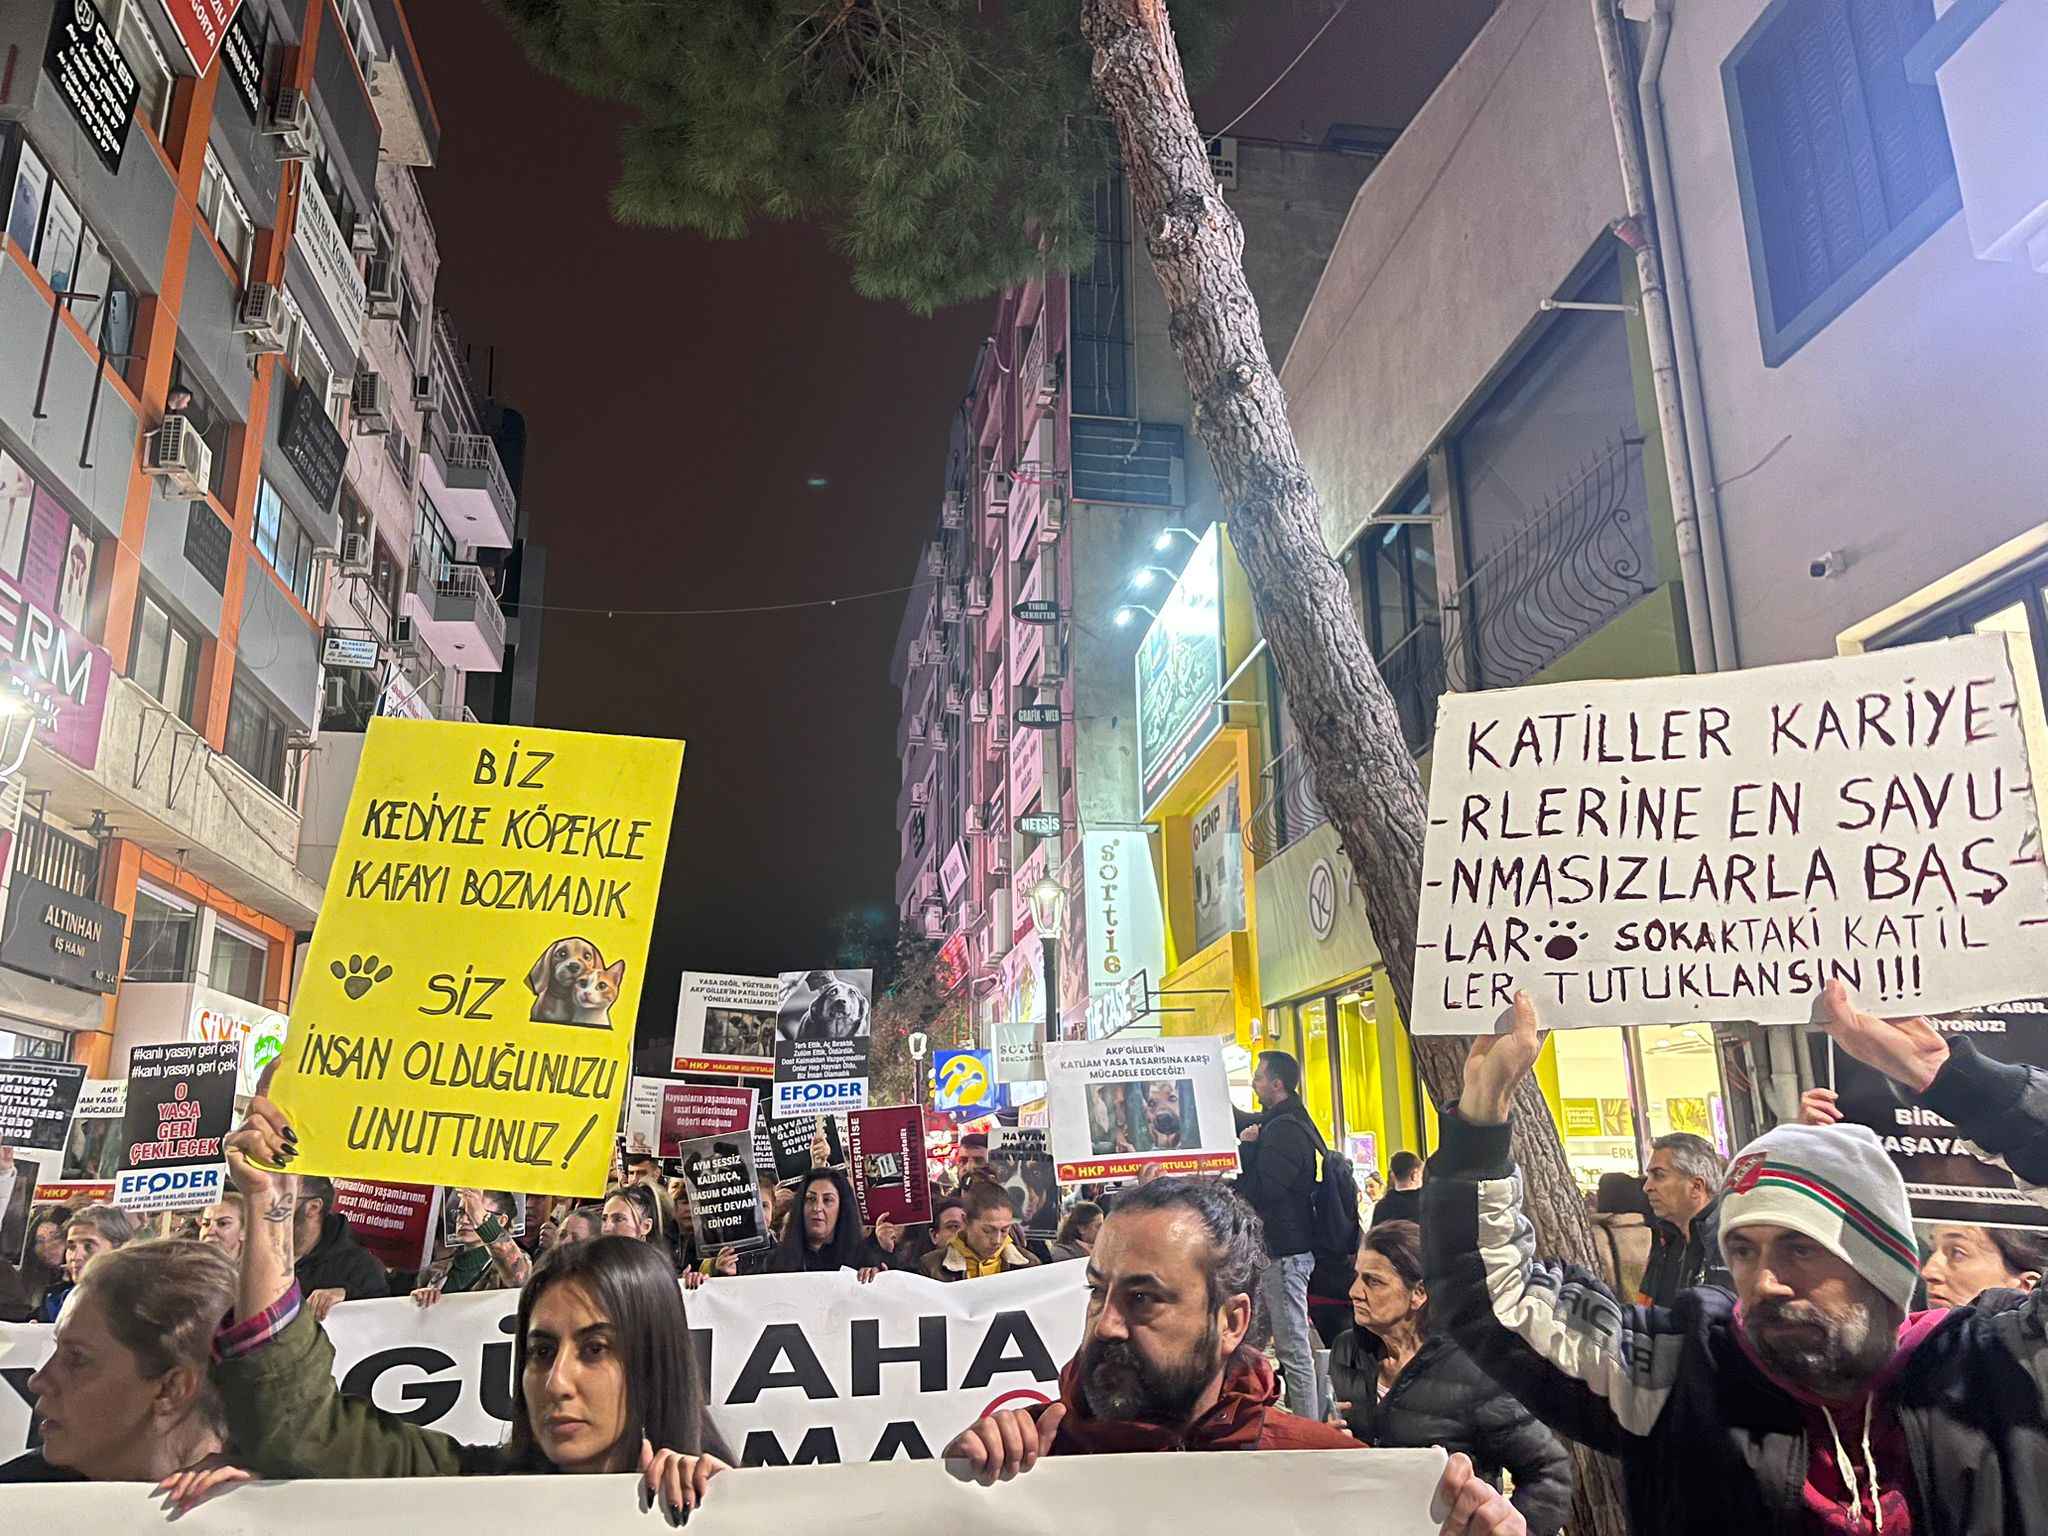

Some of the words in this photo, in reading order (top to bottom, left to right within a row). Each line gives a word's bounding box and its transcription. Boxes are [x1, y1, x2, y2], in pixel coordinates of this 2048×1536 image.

[95, 22, 134, 95] ÇEKER
[231, 23, 260, 82] AVUKAT
[1468, 703, 1732, 773] KATİLLER
[473, 739, 555, 789] BİZ
[1729, 781, 1801, 842] EN
[361, 792, 491, 846] KEDİYLE
[501, 803, 653, 861] KÖPEKLE
[1021, 815, 1060, 831] NETSİS
[346, 859, 450, 903] KAFAYI
[460, 869, 632, 920] BOZMADIK
[44, 904, 102, 943] ALTINHAN
[1614, 906, 1820, 955] SOKAKTAKİ
[417, 964, 507, 1021] SİZ
[733, 997, 763, 1005] KATLİAM
[1443, 972, 1514, 1010] LER
[133, 1047, 163, 1060] #kanlı
[165, 1045, 197, 1060] yasayı
[198, 1043, 217, 1058] geri
[219, 1041, 239, 1057] çek
[131, 1064, 161, 1078] #kanlı
[163, 1063, 195, 1079] yasayı
[196, 1060, 216, 1076] geri
[218, 1059, 237, 1075] çek
[297, 1023, 393, 1081] İNSAN
[403, 1041, 619, 1100] OLDUĞUNUZU
[689, 1061, 710, 1069] HKP
[1060, 1059, 1101, 1070] KATLİAM
[1103, 1057, 1129, 1067] YASA
[1130, 1055, 1182, 1066] TASARISINA
[1183, 1054, 1210, 1066] KARŞI
[1089, 1069, 1138, 1079] MÜCADELE
[1140, 1066, 1185, 1077] EDECEĞİZ!
[175, 1082, 188, 1101] O
[665, 1093, 703, 1104] Hayvanların
[780, 1082, 862, 1101] EFODER
[158, 1100, 201, 1121] YASA
[157, 1117, 197, 1139] GERİ
[1002, 1131, 1046, 1141] HAYVAN
[130, 1137, 220, 1165] ÇEKİLECEK
[852, 1138, 864, 1179] MEŞRU
[692, 1161, 711, 1172] AYM
[712, 1154, 741, 1168] SESSİZ
[1078, 1165, 1105, 1177] HKP
[1110, 1163, 1142, 1173] HALKI
[121, 1170, 218, 1194] EFODER
[697, 1171, 741, 1185] KALDIKÇA,
[42, 1188, 68, 1197] HKP
[690, 1188, 720, 1201] MASUM
[721, 1182, 757, 1197] CANLAR
[693, 1202, 723, 1216] ÖLMEYE
[724, 1198, 757, 1212] DEVAM
[708, 1215, 742, 1229] EDİYOR!
